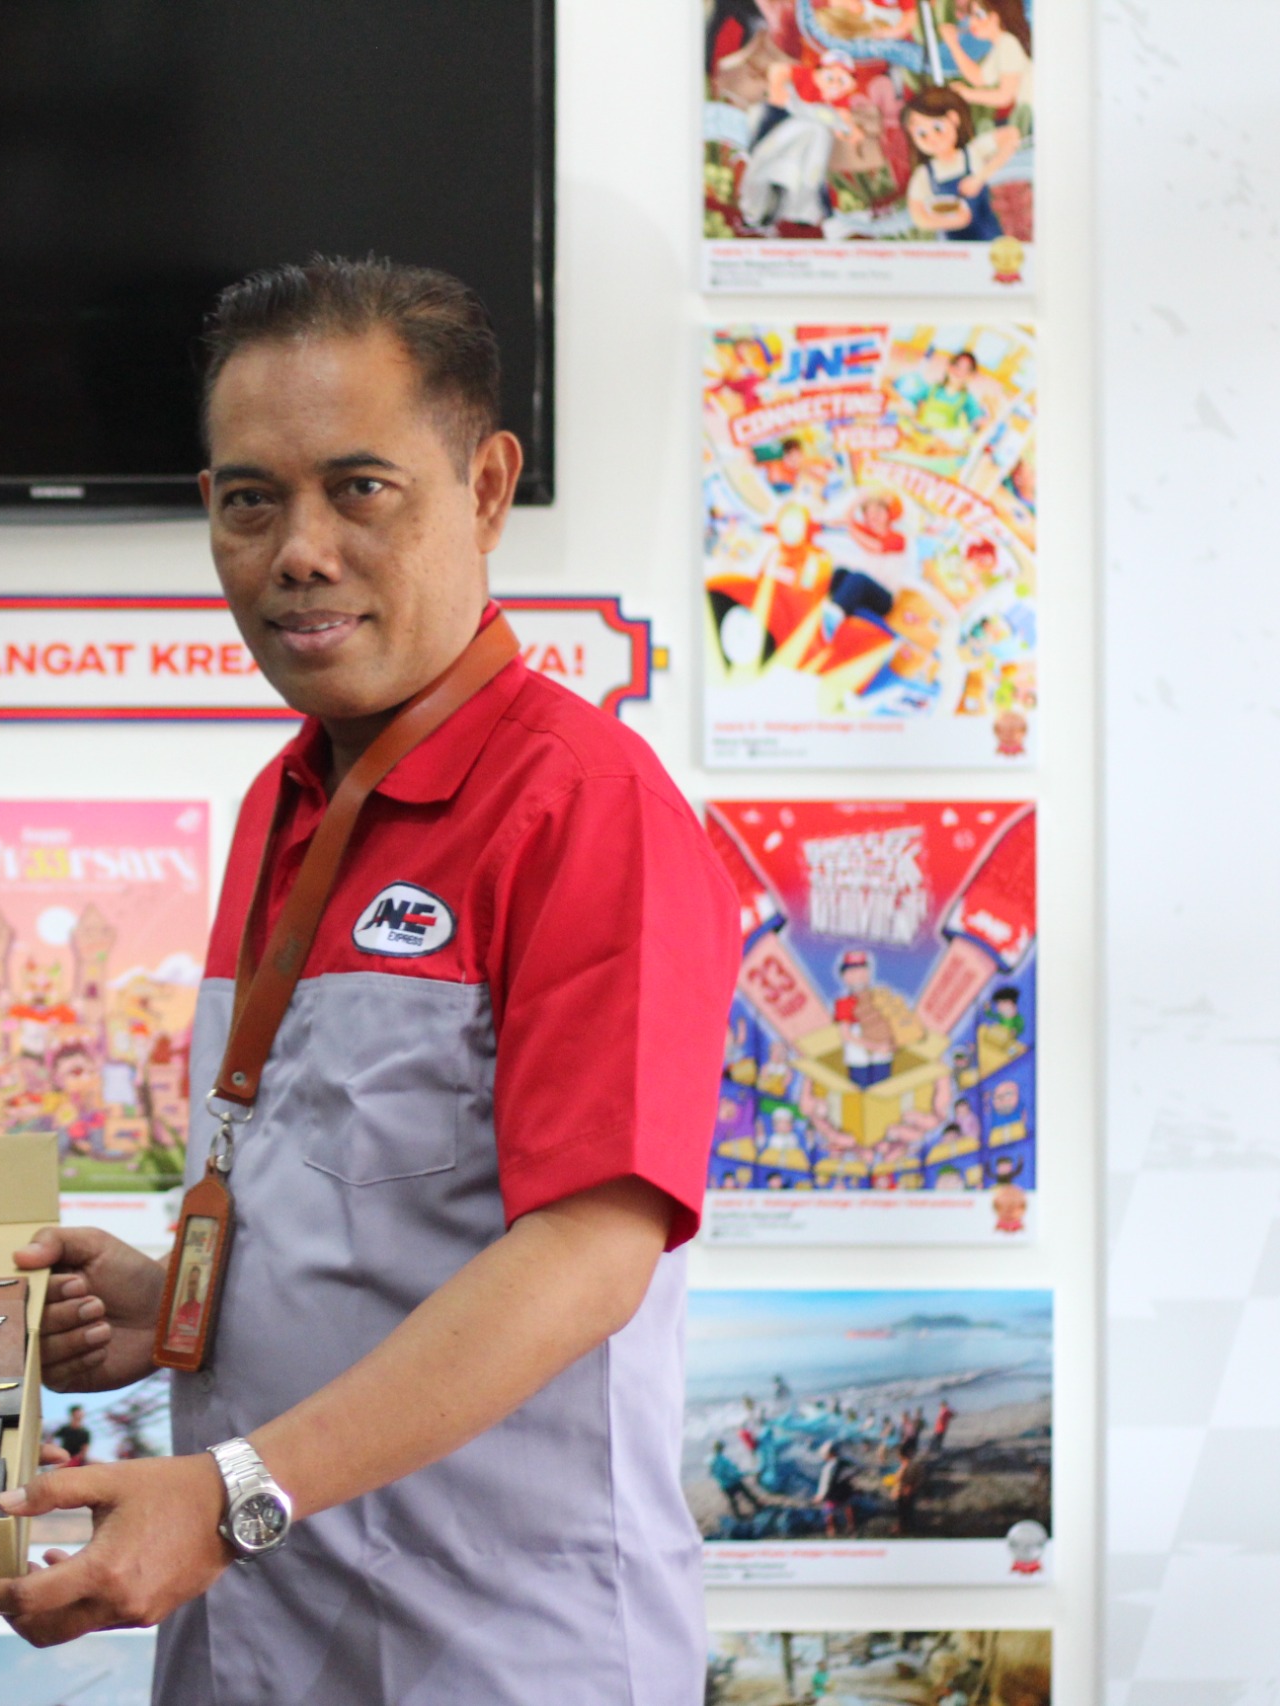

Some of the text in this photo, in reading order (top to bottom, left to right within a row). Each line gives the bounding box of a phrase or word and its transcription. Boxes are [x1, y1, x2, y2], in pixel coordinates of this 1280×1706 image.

[778, 341, 880, 383] JNE
[357, 897, 437, 935] JNE
[387, 931, 424, 947] EXPRESS
